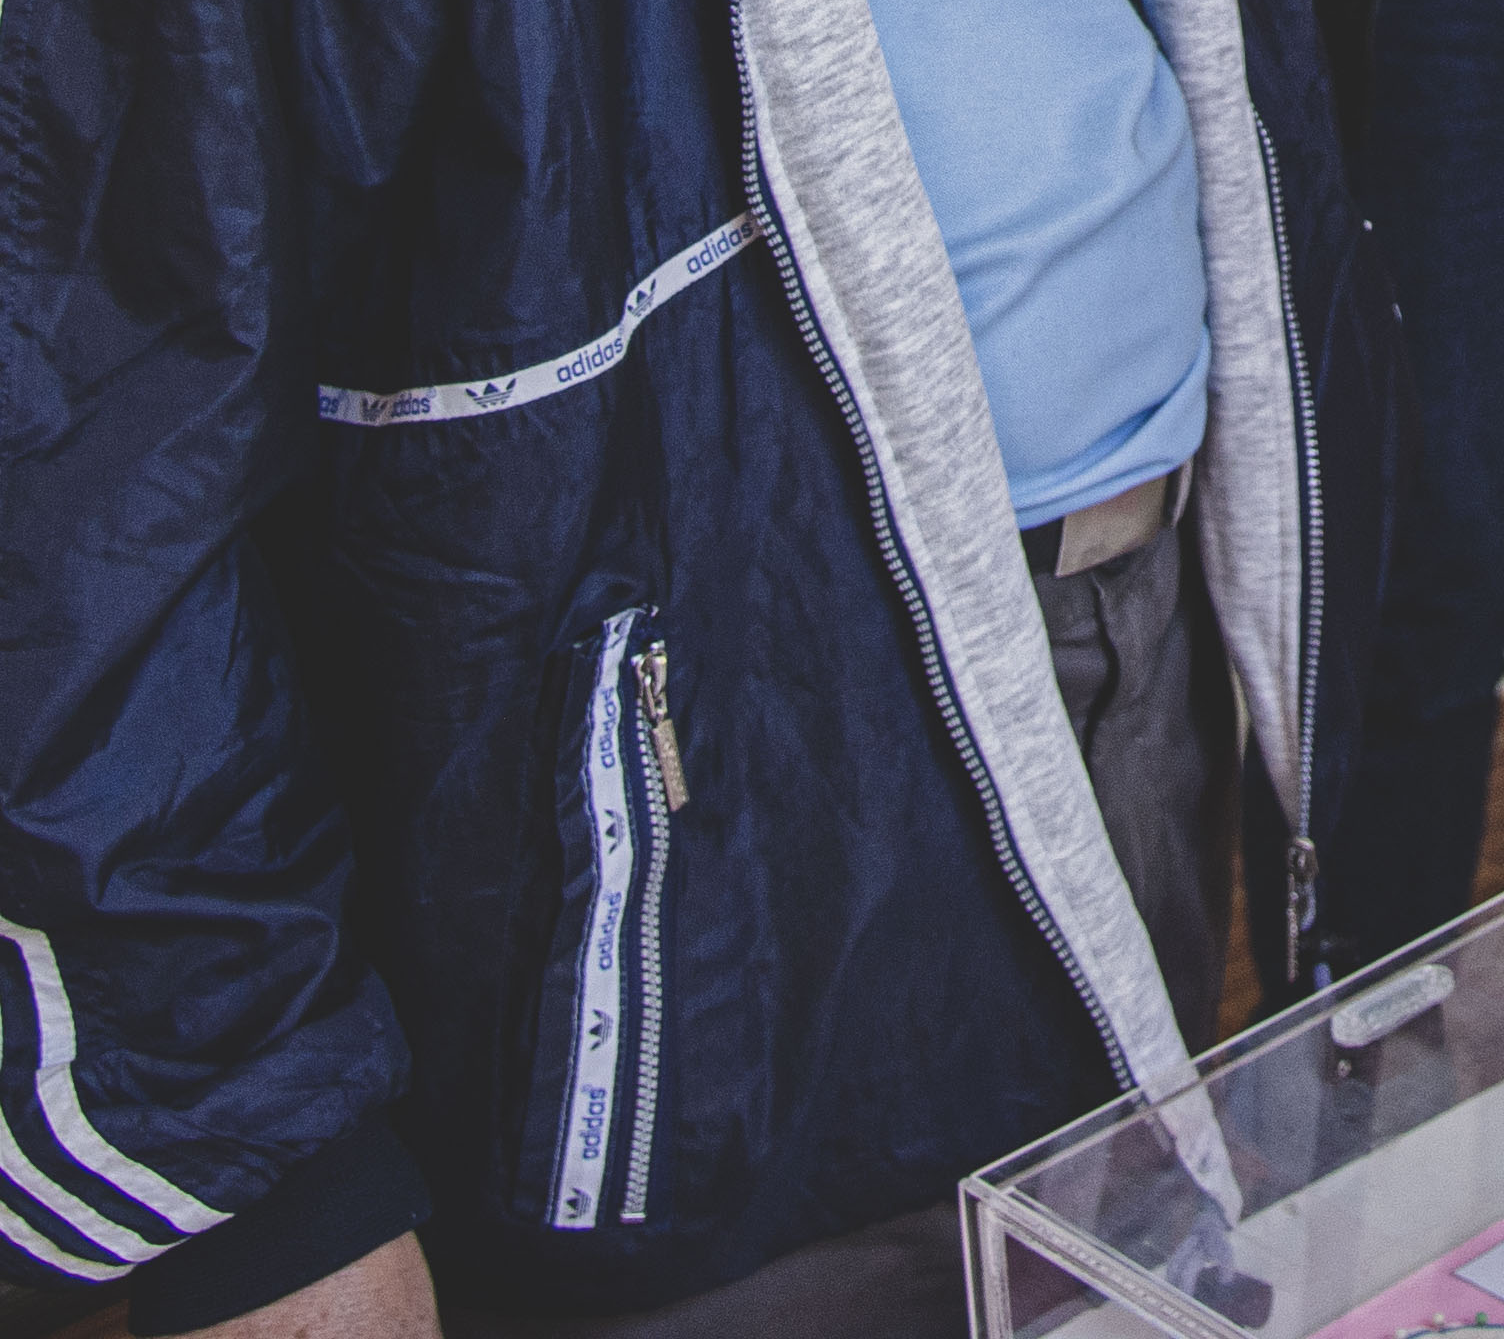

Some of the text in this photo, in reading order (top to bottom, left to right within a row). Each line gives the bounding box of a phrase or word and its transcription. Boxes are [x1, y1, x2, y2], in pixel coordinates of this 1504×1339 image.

[686, 219, 754, 276] adidas
[556, 334, 624, 385] adidas
[599, 686, 617, 769] adidas
[598, 891, 622, 971] adidas
[582, 1087, 606, 1161] adidas
